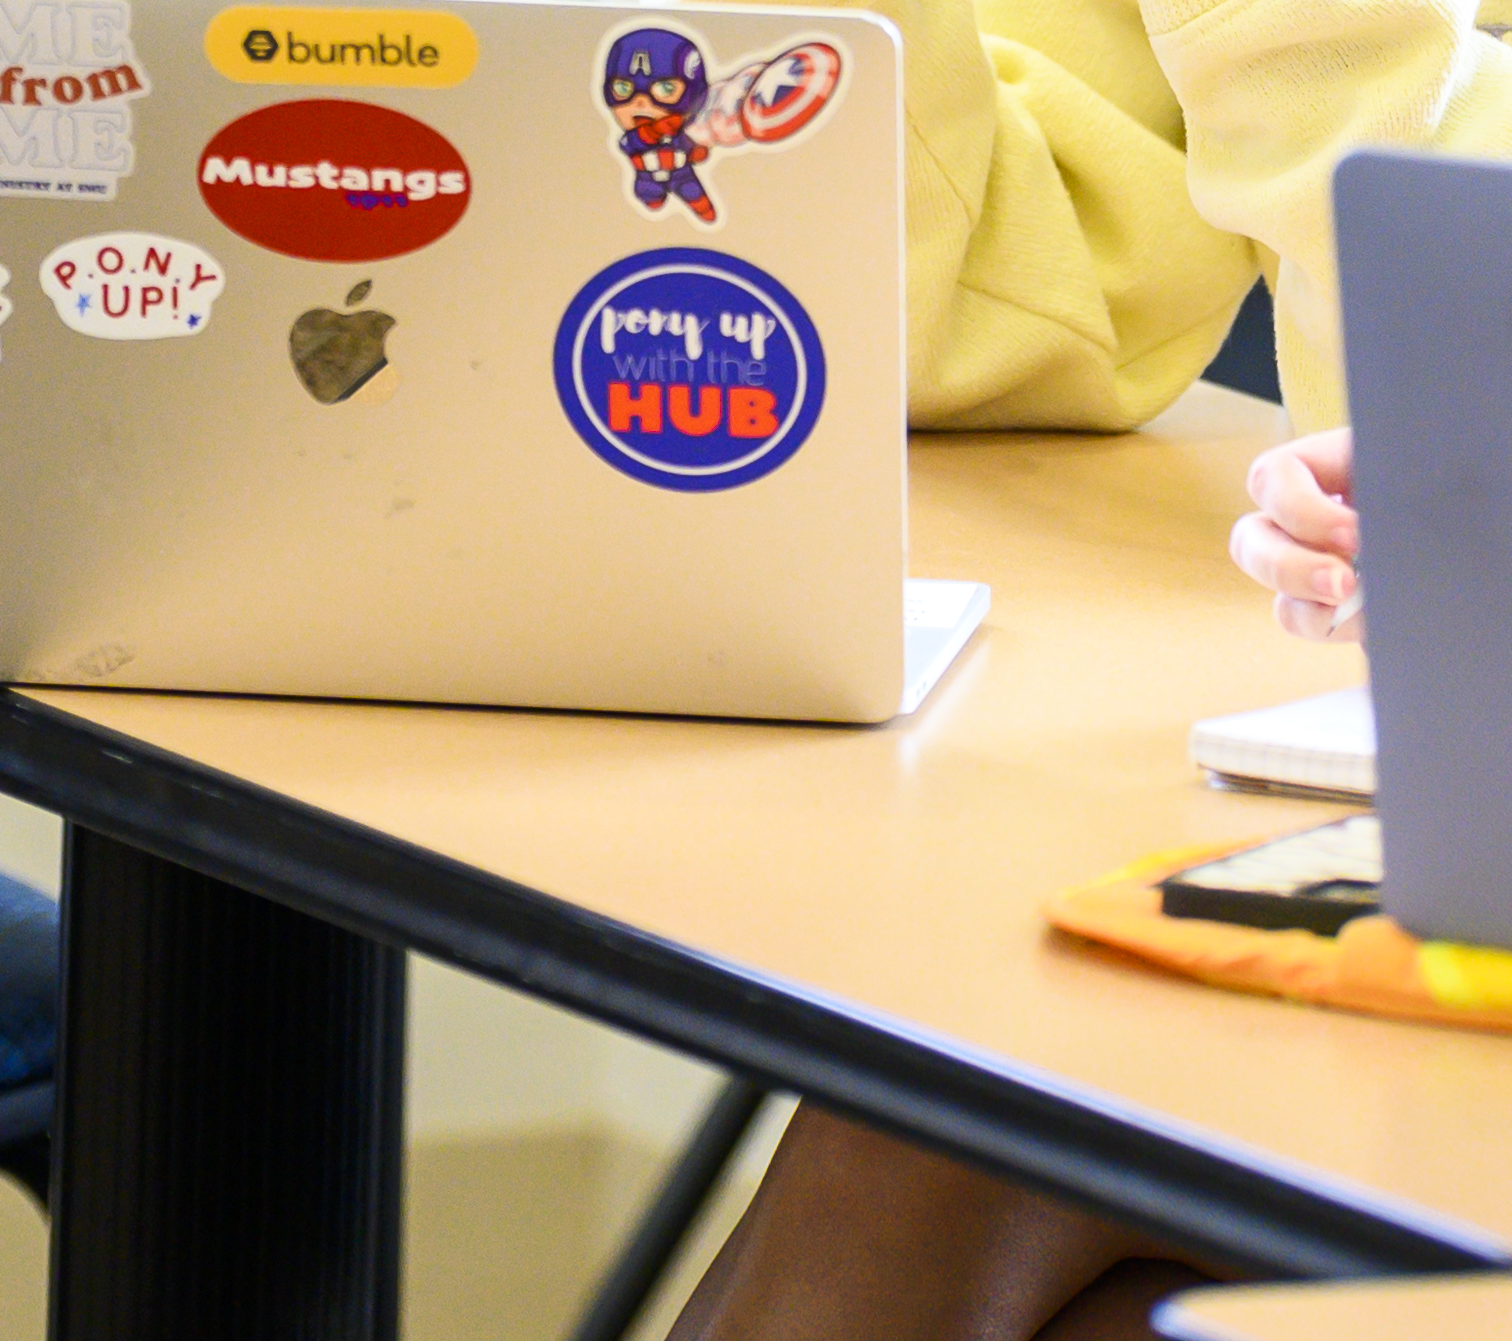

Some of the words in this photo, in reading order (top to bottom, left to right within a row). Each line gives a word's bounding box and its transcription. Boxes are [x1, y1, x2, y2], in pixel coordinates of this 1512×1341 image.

[287, 30, 440, 68] bumble
[201, 155, 466, 201] Mustangs
[102, 284, 179, 319] UP!
[600, 305, 710, 361] pony
[719, 311, 776, 361] up
[612, 348, 695, 383] with
[706, 348, 768, 387] the
[607, 380, 780, 439] HUB
